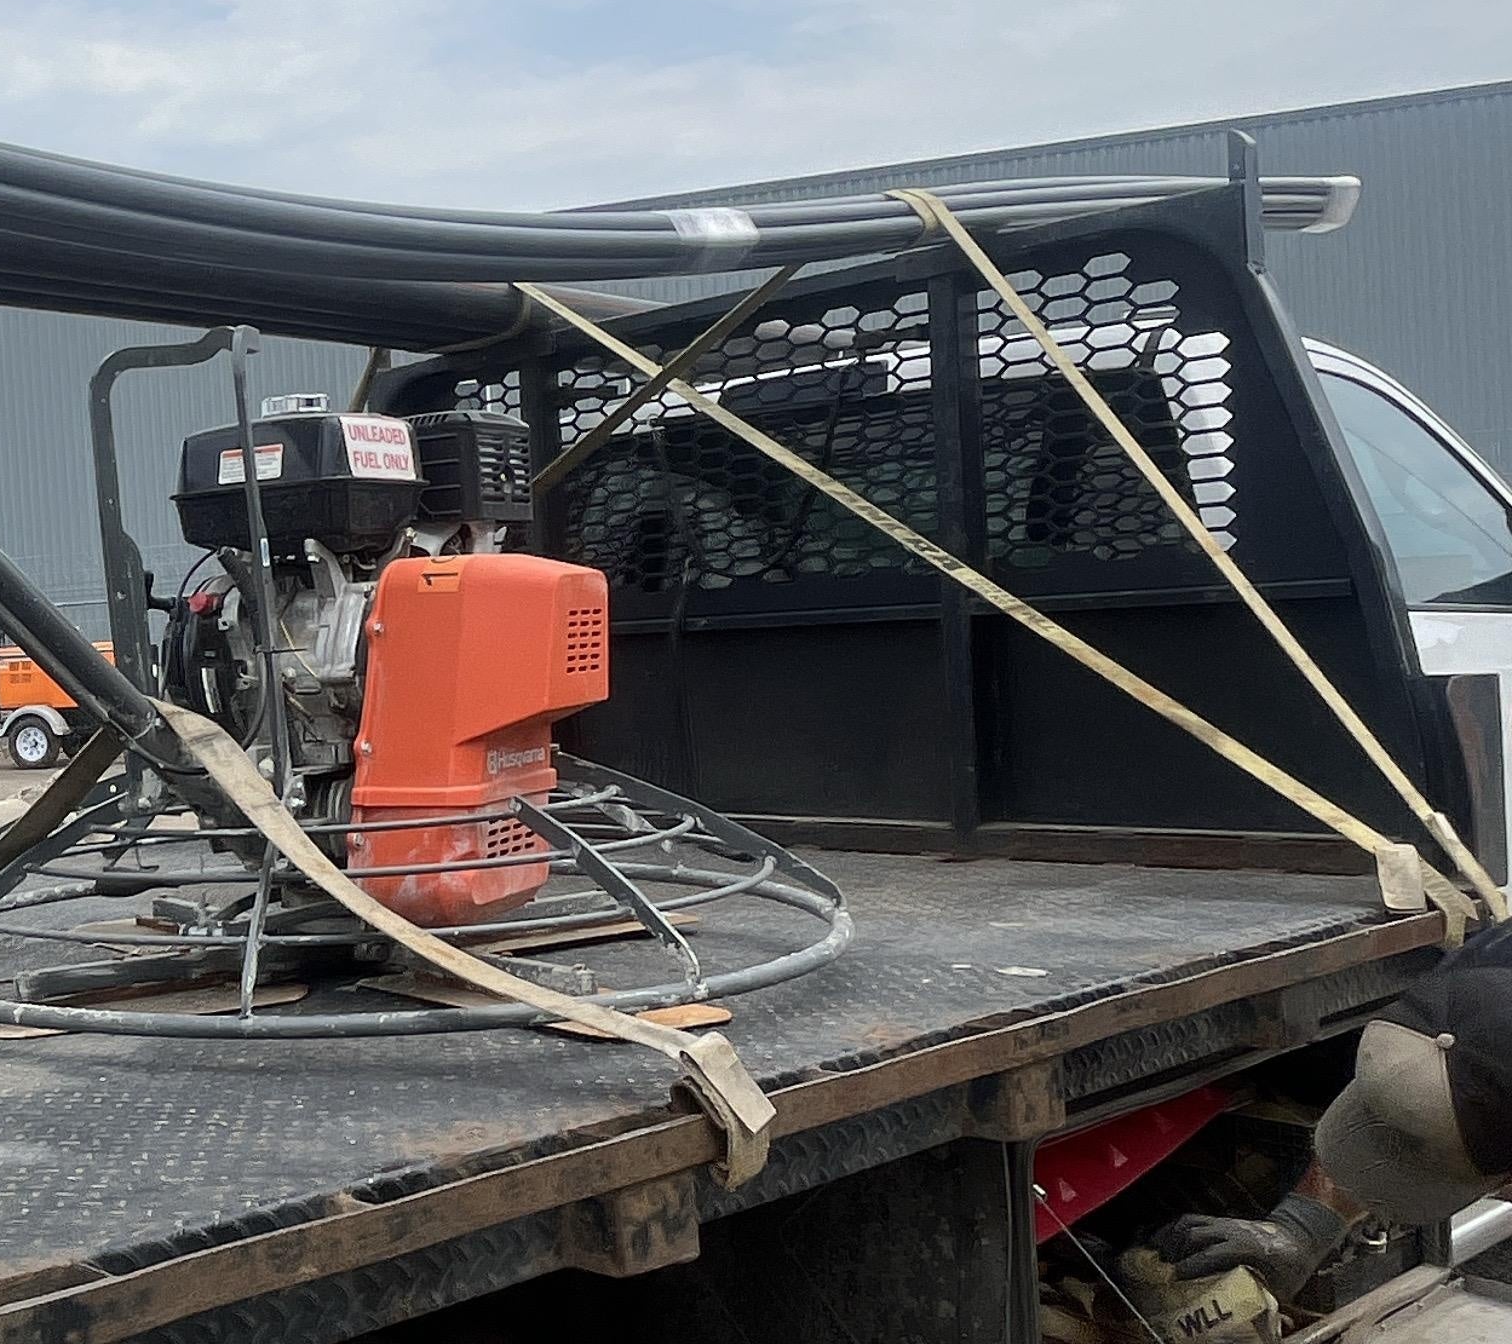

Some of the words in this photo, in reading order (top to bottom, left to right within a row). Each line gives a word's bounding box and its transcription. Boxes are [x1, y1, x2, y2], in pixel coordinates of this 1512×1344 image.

[348, 423, 407, 445] UNLEADED
[353, 451, 381, 469] FUEL
[383, 453, 409, 471] ONLY
[1177, 1299, 1233, 1337] WLL
